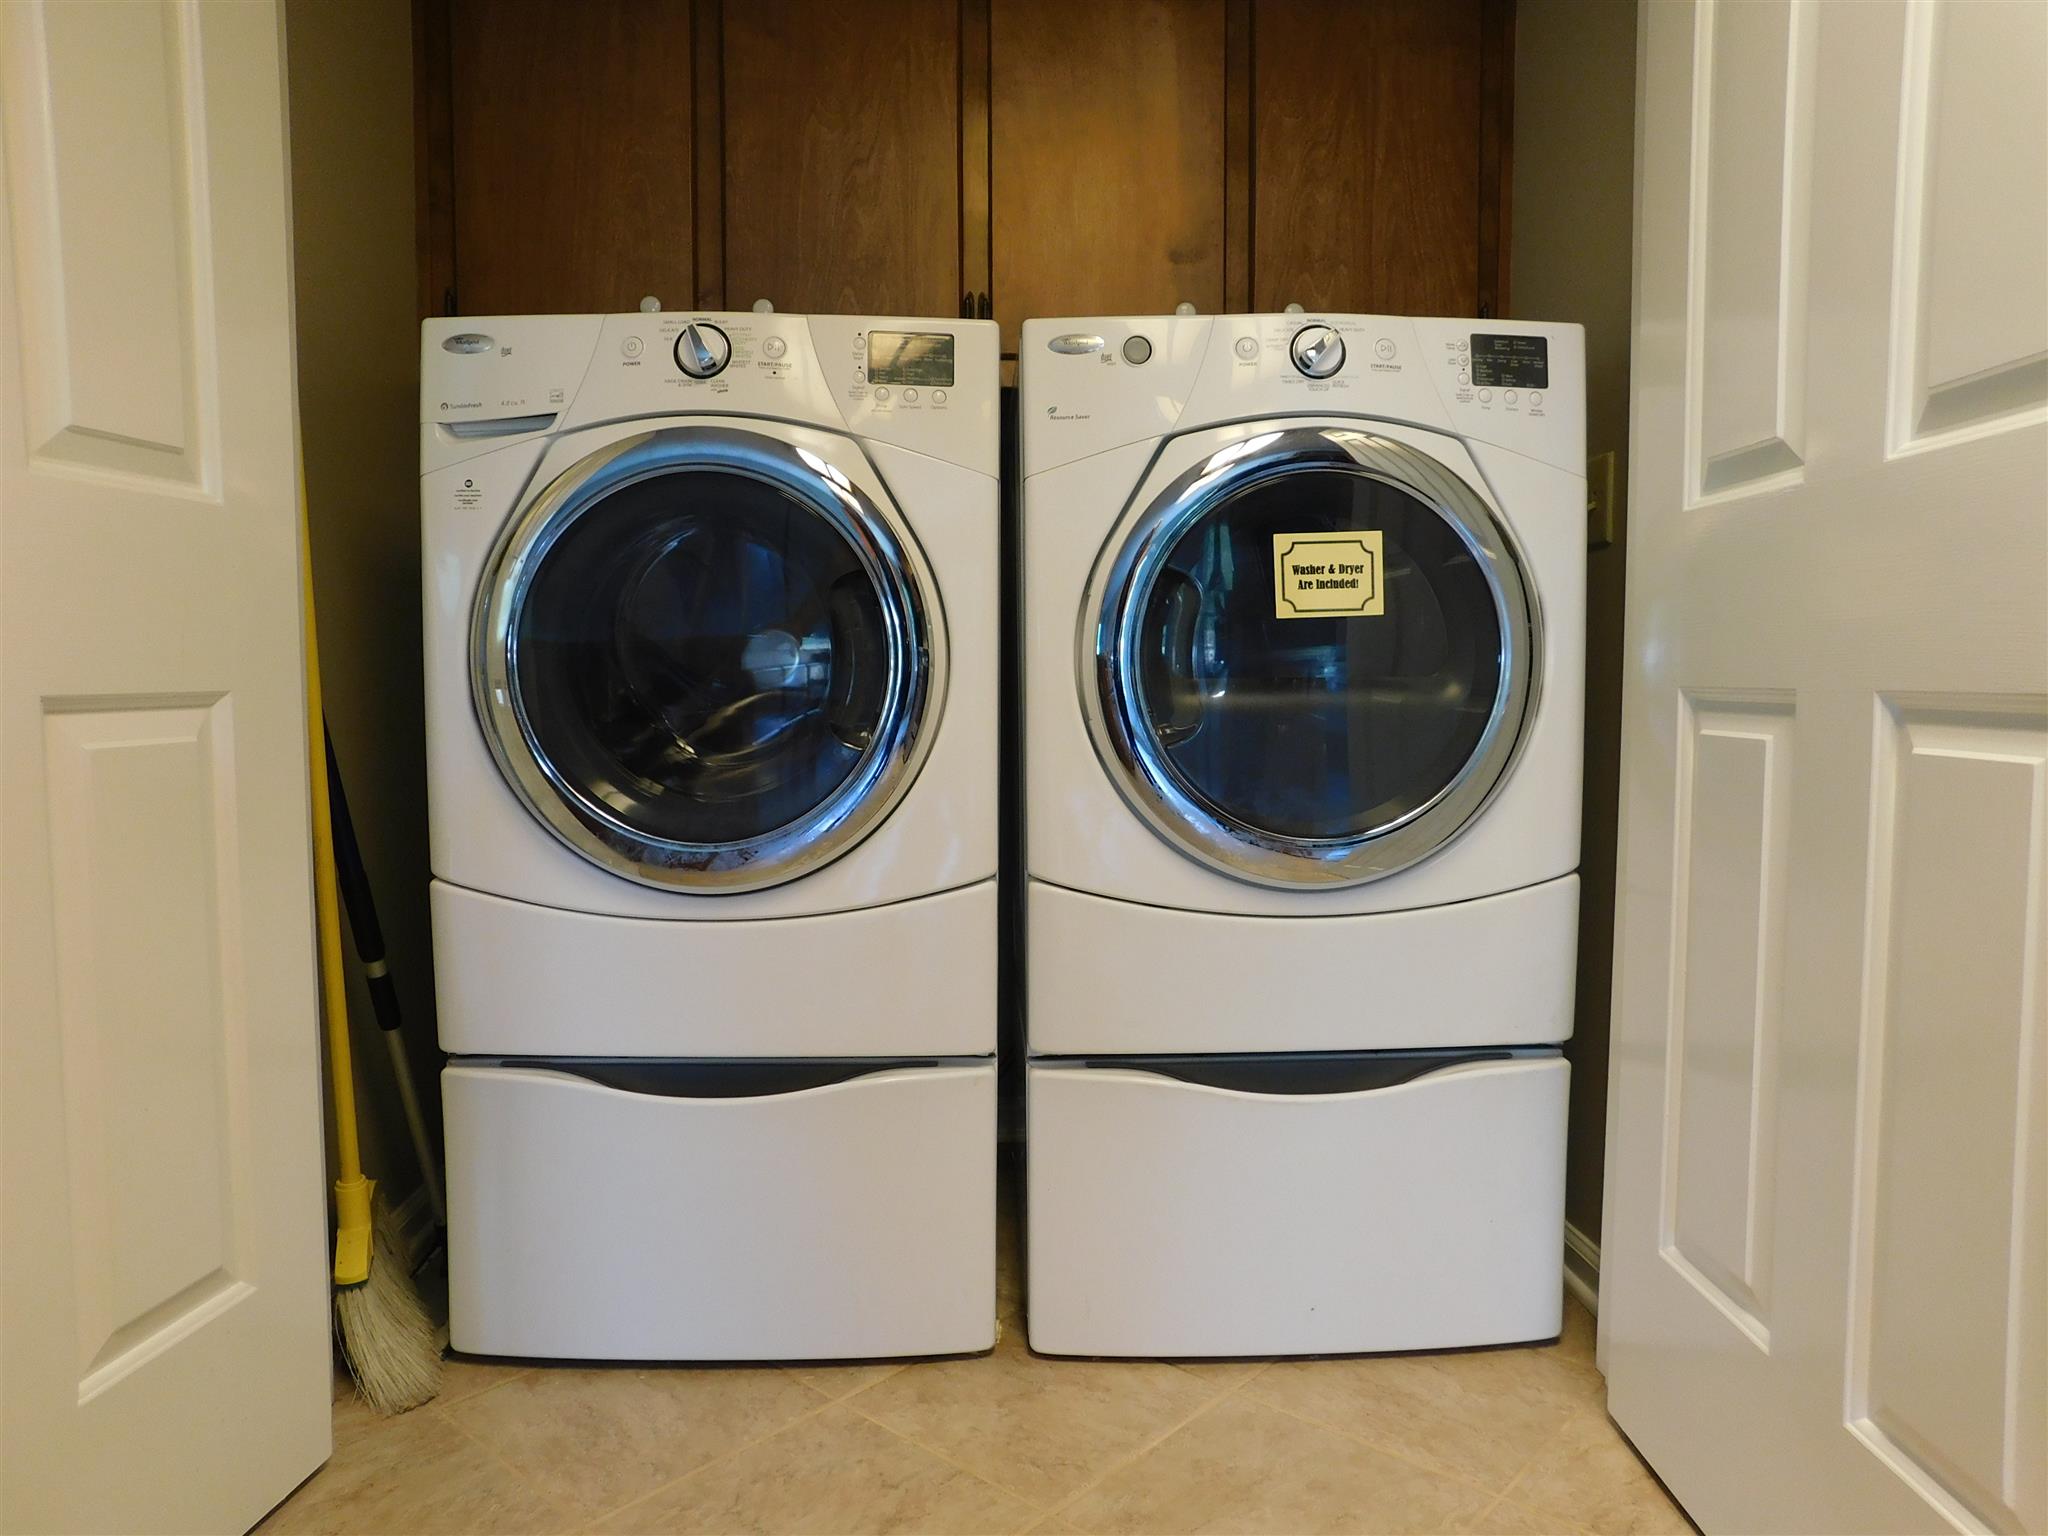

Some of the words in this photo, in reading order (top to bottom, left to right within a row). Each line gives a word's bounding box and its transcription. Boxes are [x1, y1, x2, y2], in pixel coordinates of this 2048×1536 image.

[1292, 564, 1325, 576] Washer
[1328, 564, 1336, 574] &
[1339, 563, 1364, 575] Dryer
[1298, 579, 1314, 590] Are
[1316, 578, 1359, 590] Included!
